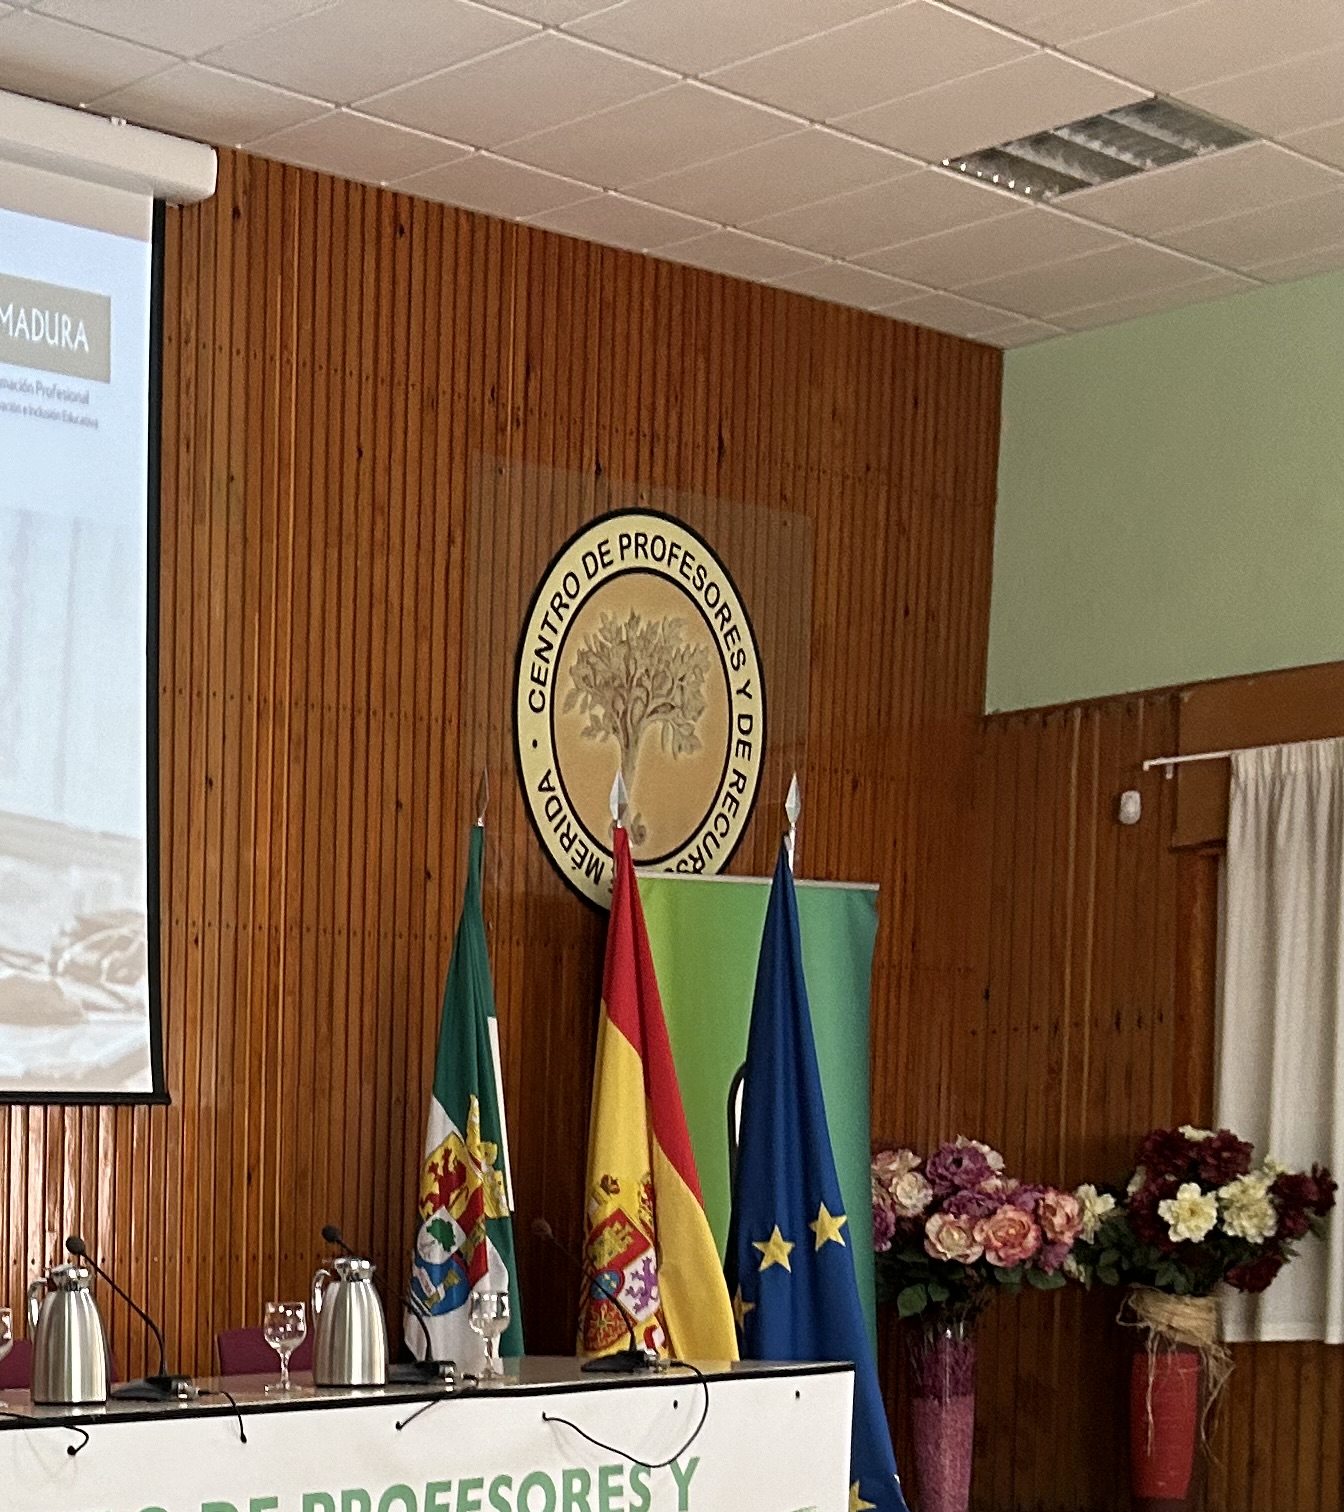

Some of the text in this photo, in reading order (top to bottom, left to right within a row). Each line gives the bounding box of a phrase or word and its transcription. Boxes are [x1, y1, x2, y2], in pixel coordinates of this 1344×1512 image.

[581, 538, 614, 581] DE
[618, 532, 746, 672] PROFESORES
[528, 571, 581, 713] CENTRO
[735, 678, 753, 701] Y
[734, 713, 754, 762] DE
[537, 768, 606, 886] MÉRIDA
[668, 1456, 701, 1512] Y
